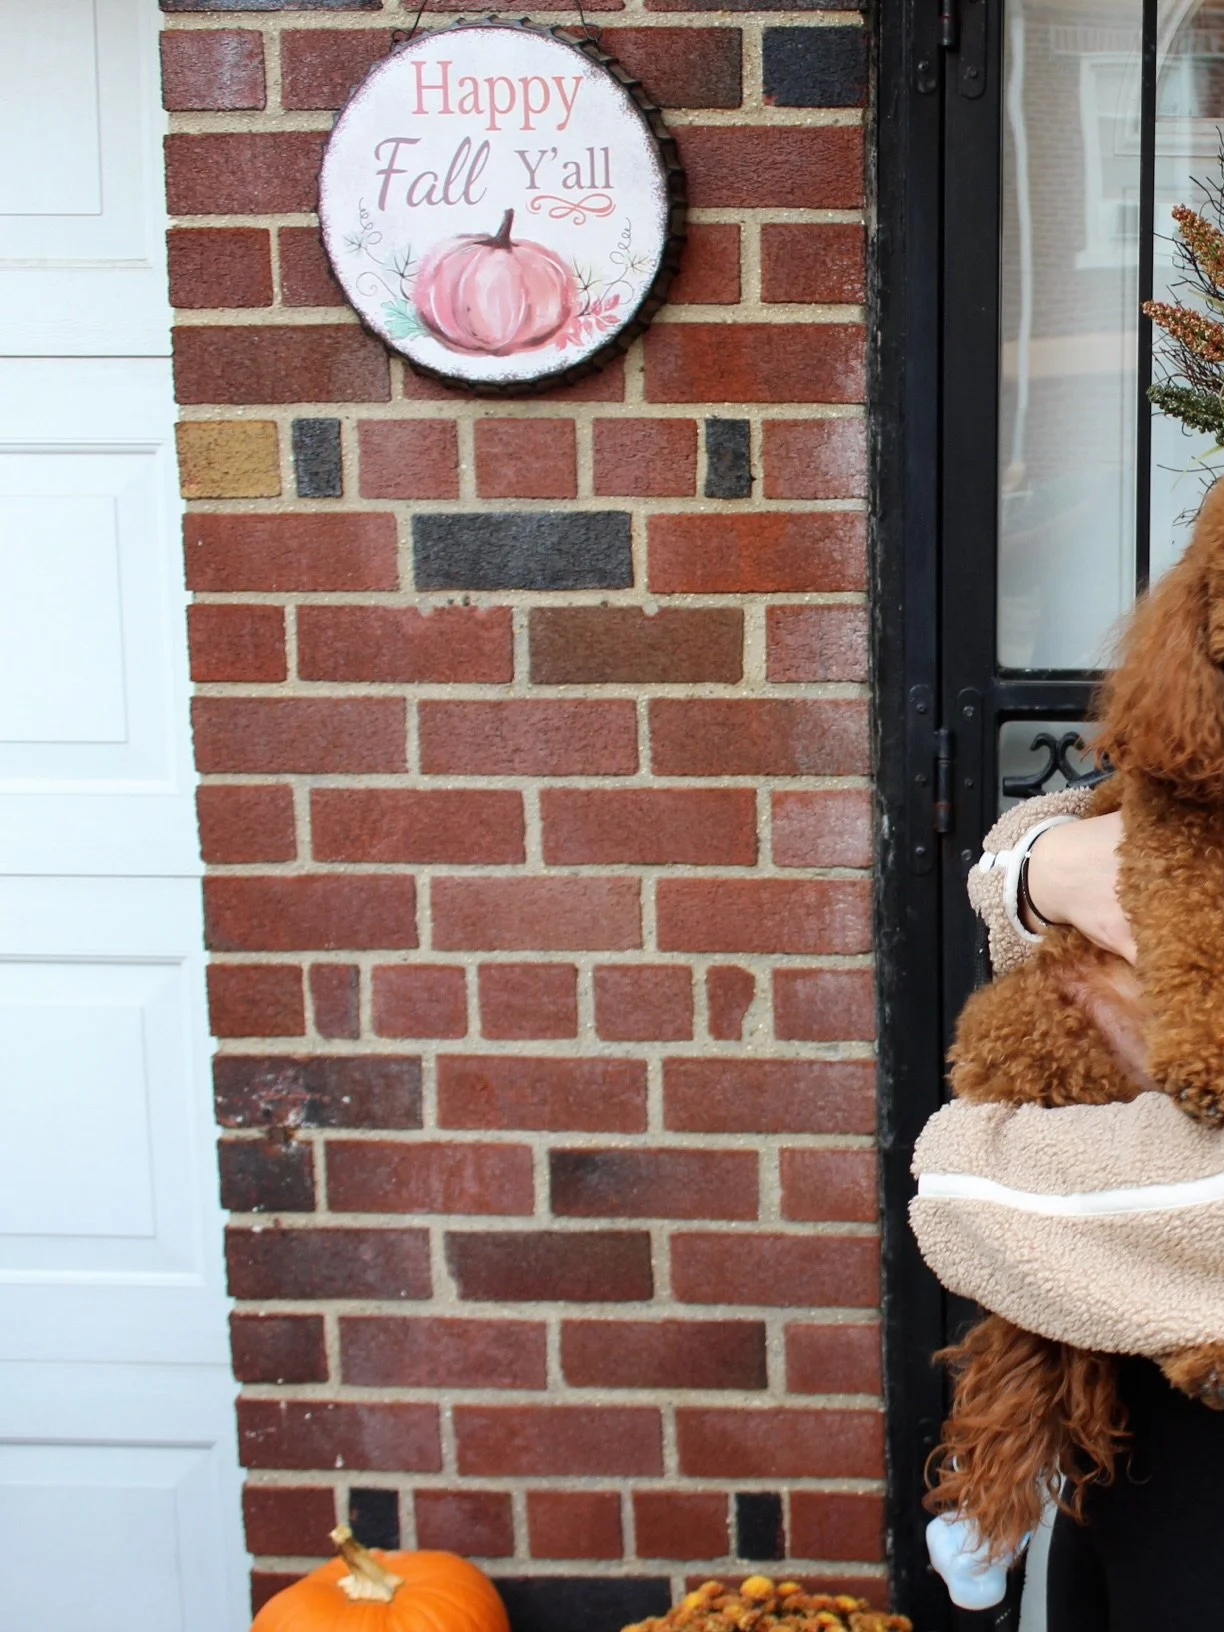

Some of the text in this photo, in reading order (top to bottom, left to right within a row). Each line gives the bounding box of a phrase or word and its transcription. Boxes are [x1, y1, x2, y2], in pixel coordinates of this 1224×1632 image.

[411, 60, 584, 132] Happy
[374, 136, 615, 212] Fall Y'all
